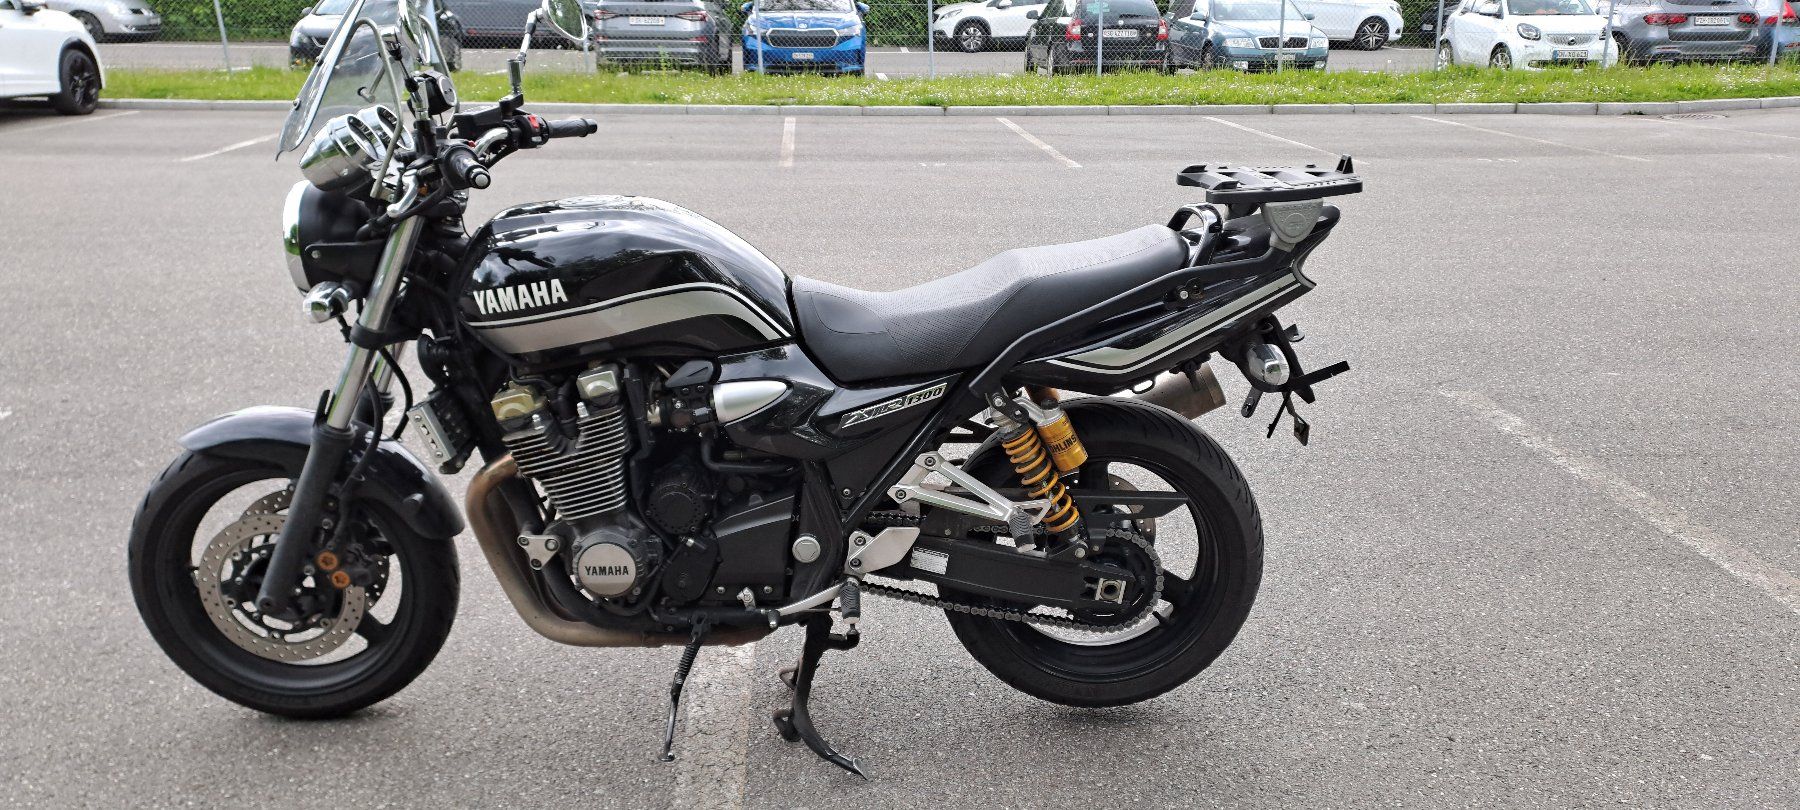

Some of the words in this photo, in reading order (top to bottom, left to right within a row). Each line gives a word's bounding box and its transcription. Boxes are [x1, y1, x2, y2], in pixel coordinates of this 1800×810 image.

[472, 278, 569, 315] YAMAHA
[841, 397, 906, 428] XJR
[905, 386, 945, 407] 1300
[584, 565, 630, 576] YAMAHA
